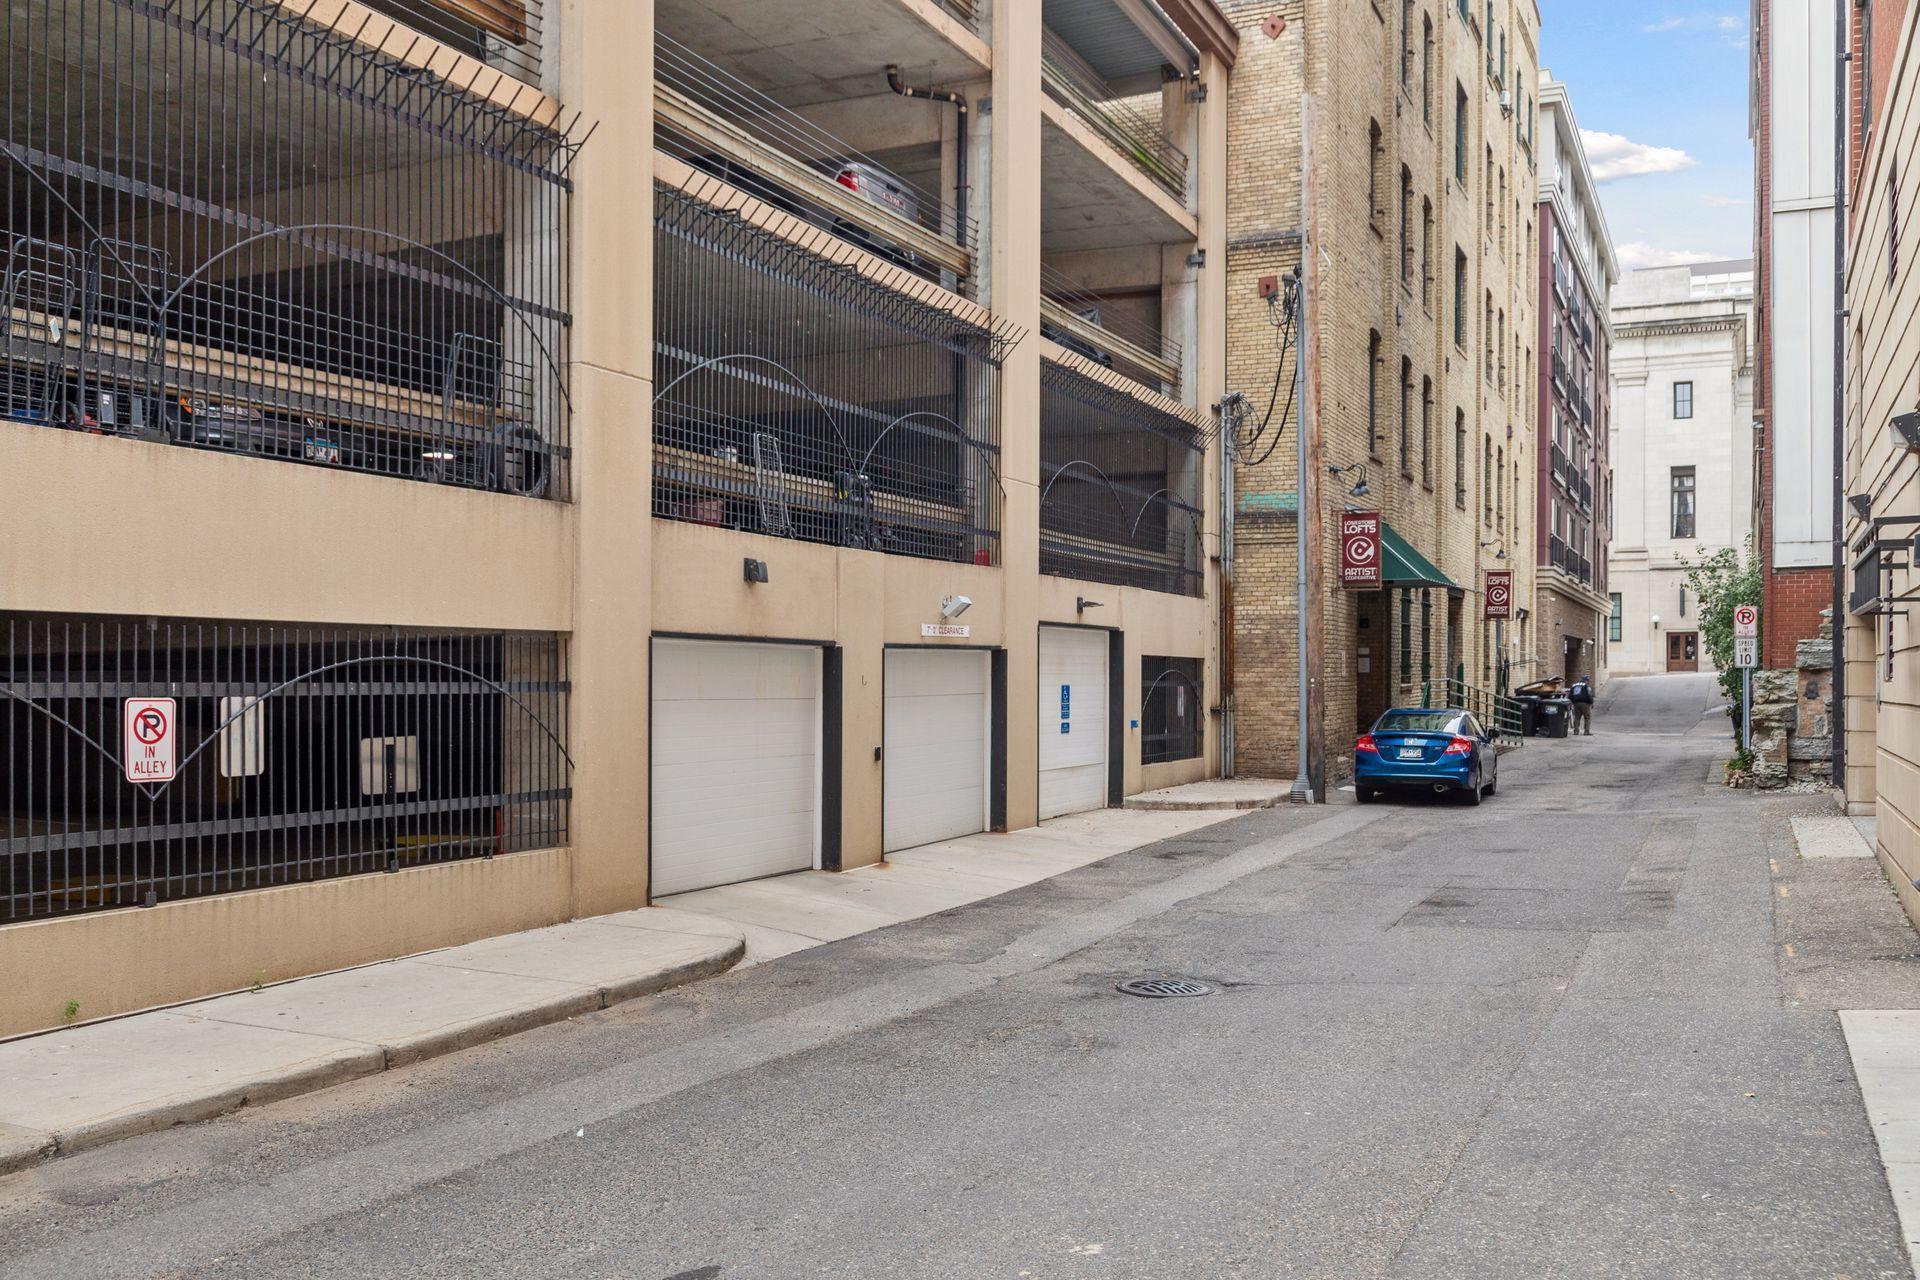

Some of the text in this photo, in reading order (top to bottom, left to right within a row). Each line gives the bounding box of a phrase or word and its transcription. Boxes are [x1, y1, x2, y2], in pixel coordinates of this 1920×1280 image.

[1344, 525, 1376, 534] LOFTS
[1345, 567, 1376, 576] ARTIST
[939, 626, 964, 635] CLEARANCE
[1740, 653, 1752, 665] 10
[145, 746, 156, 758] IN
[134, 761, 167, 774] ALLEY
